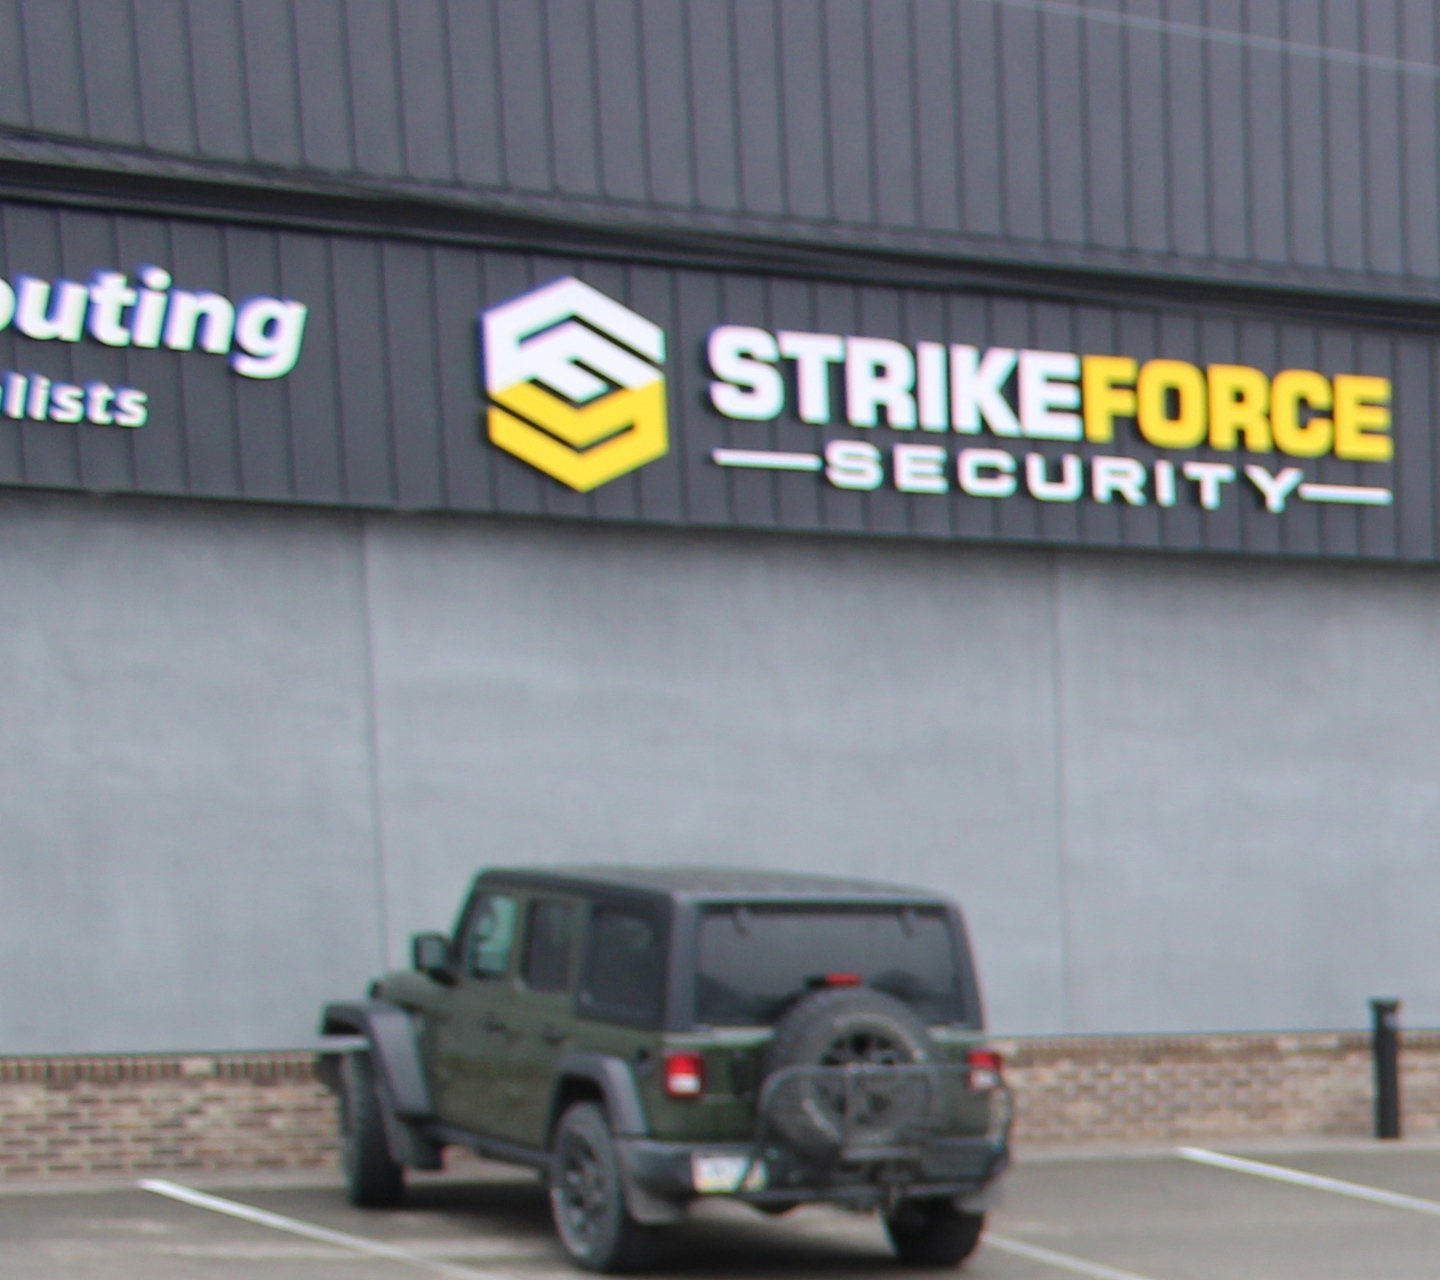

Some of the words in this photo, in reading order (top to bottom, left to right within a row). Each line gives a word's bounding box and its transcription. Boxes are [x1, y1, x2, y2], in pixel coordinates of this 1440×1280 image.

[0, 265, 307, 379] uting
[0, 371, 148, 427] lists
[707, 325, 1394, 462] STRIKEFORCE
[824, 439, 1303, 512] SECURITY
